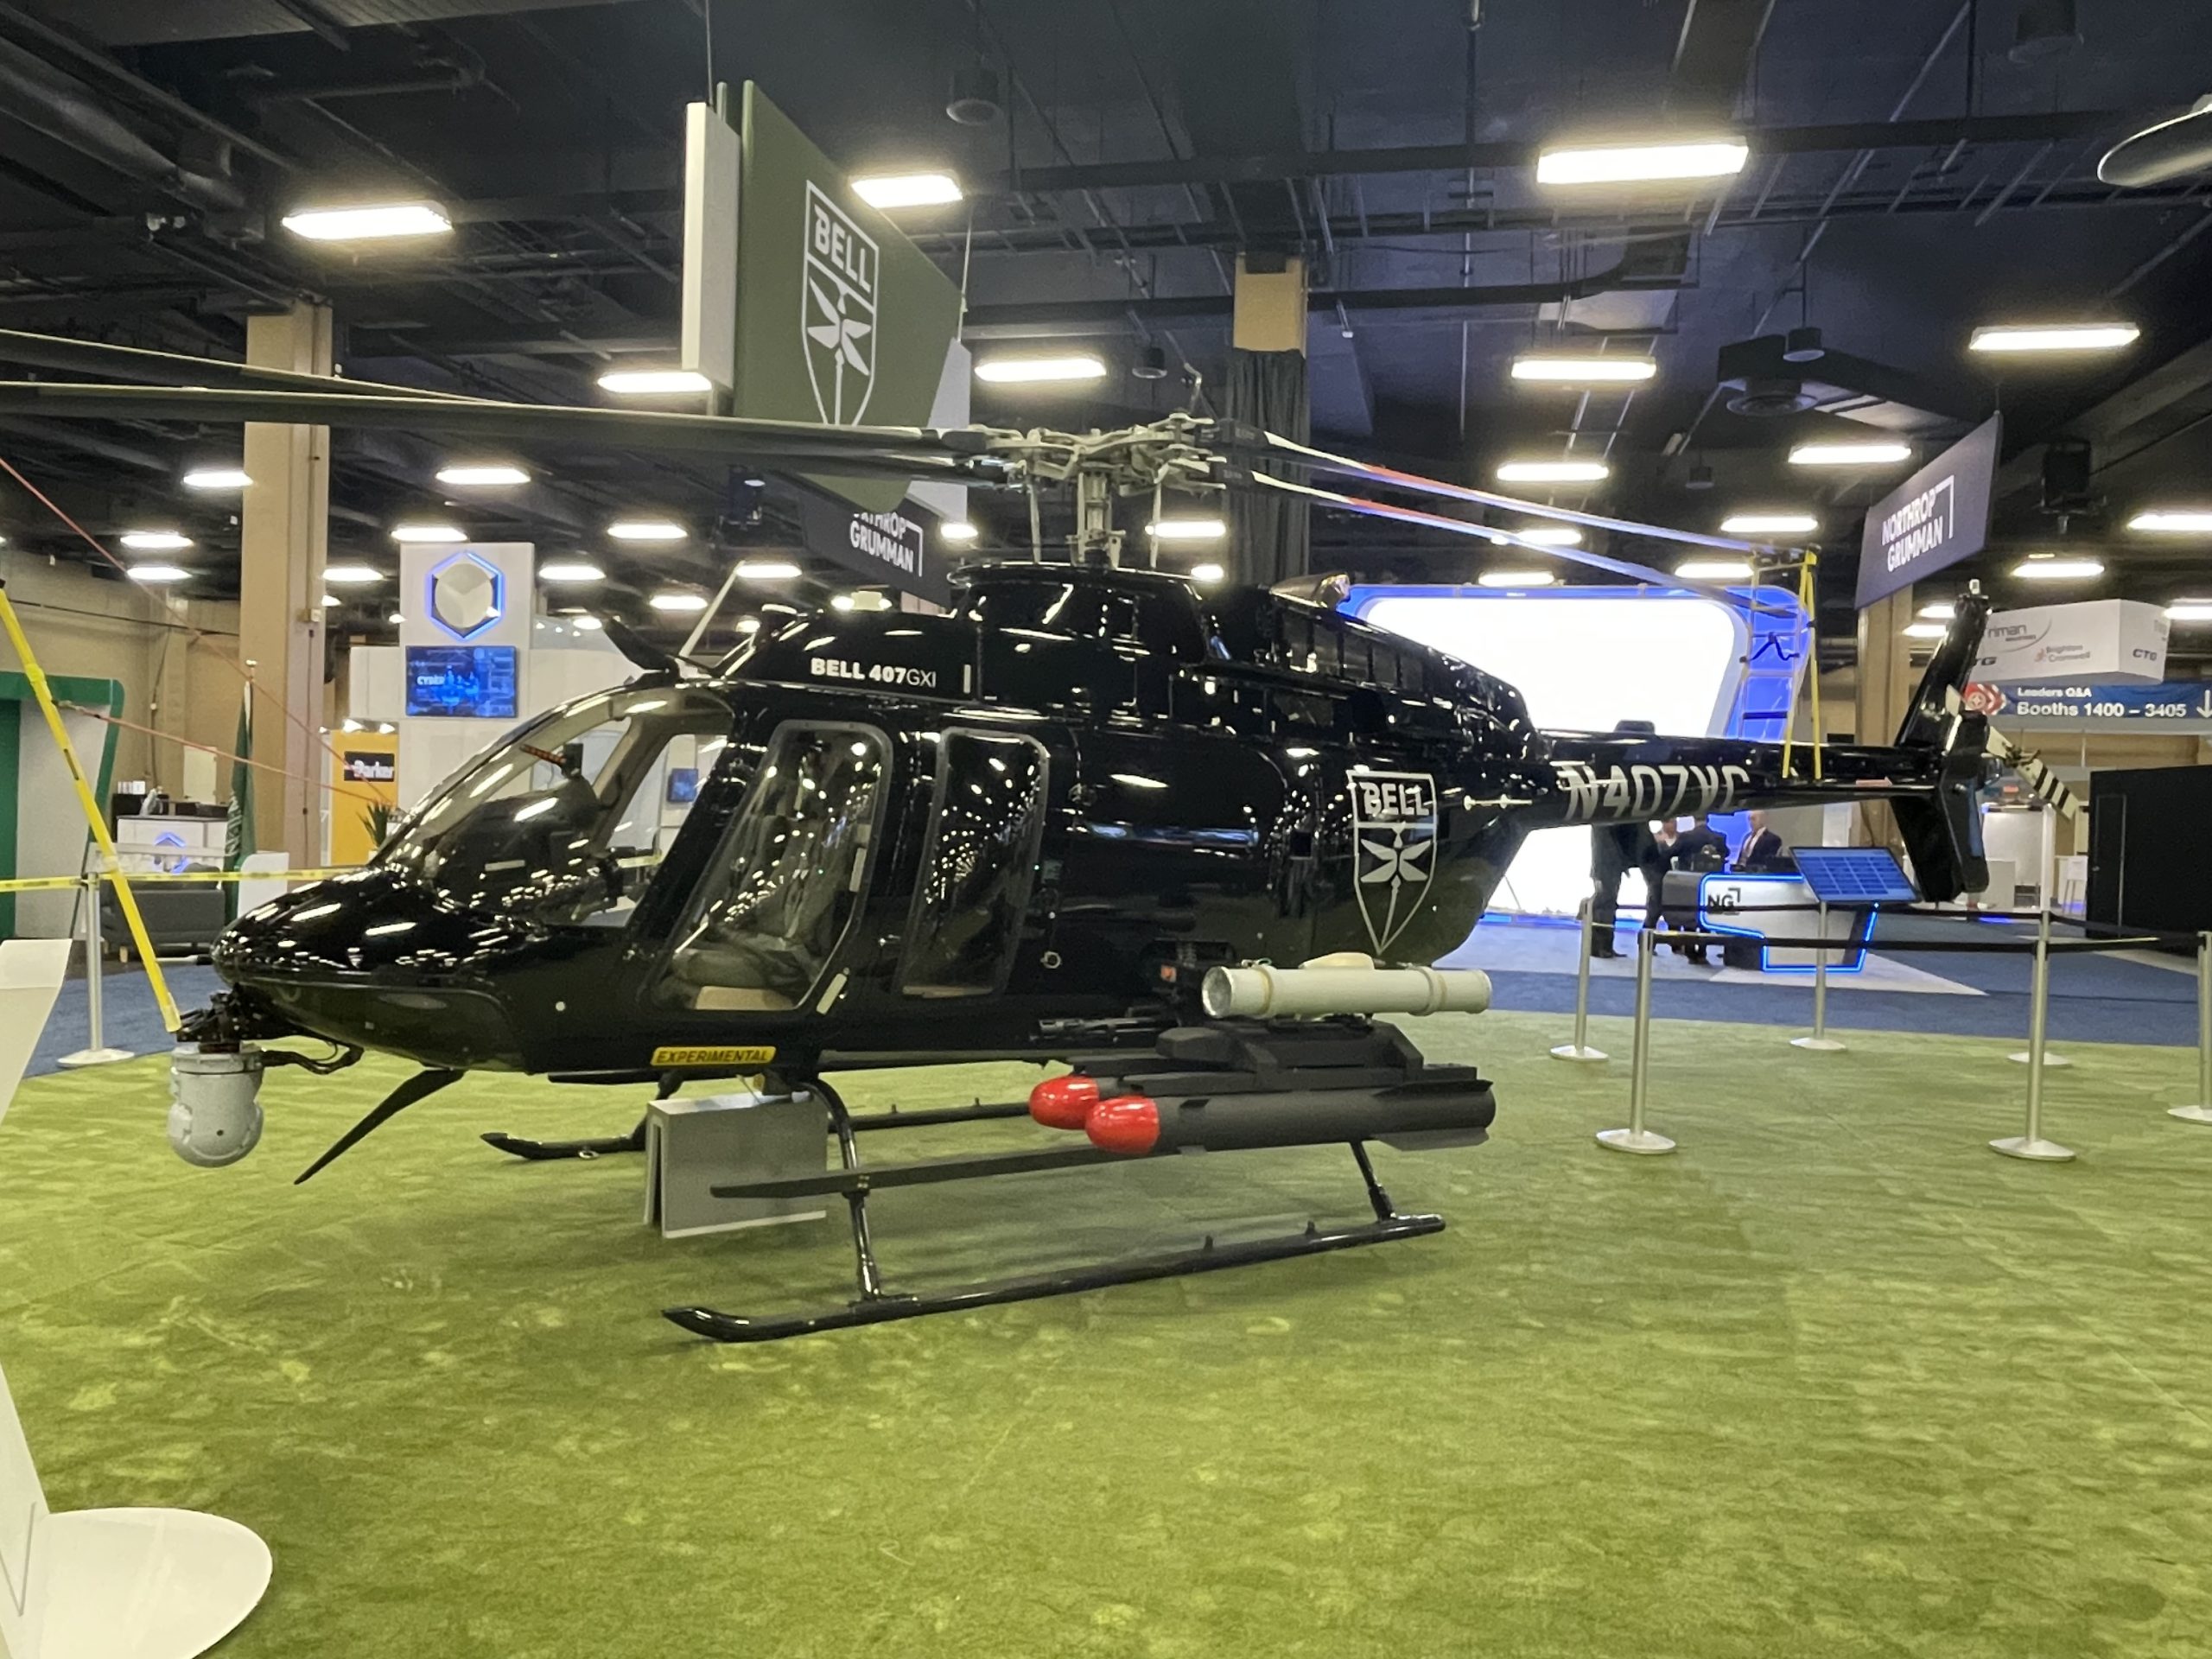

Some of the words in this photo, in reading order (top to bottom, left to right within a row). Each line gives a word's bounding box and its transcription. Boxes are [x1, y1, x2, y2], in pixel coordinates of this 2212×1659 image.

[814, 203, 871, 294] BELL
[1882, 487, 1936, 546] NORTHROP
[850, 520, 914, 573] GRUMMAN
[1887, 515, 1943, 573] GRUMMAN
[810, 657, 865, 681] BELL
[2017, 702, 2079, 717] Booths
[2085, 702, 2125, 717] 1400
[2144, 702, 2187, 718] 3405
[2065, 687, 2093, 698] Q&A
[1359, 781, 1430, 816] BELL
[656, 1050, 768, 1064] EXPERIMENTAL
